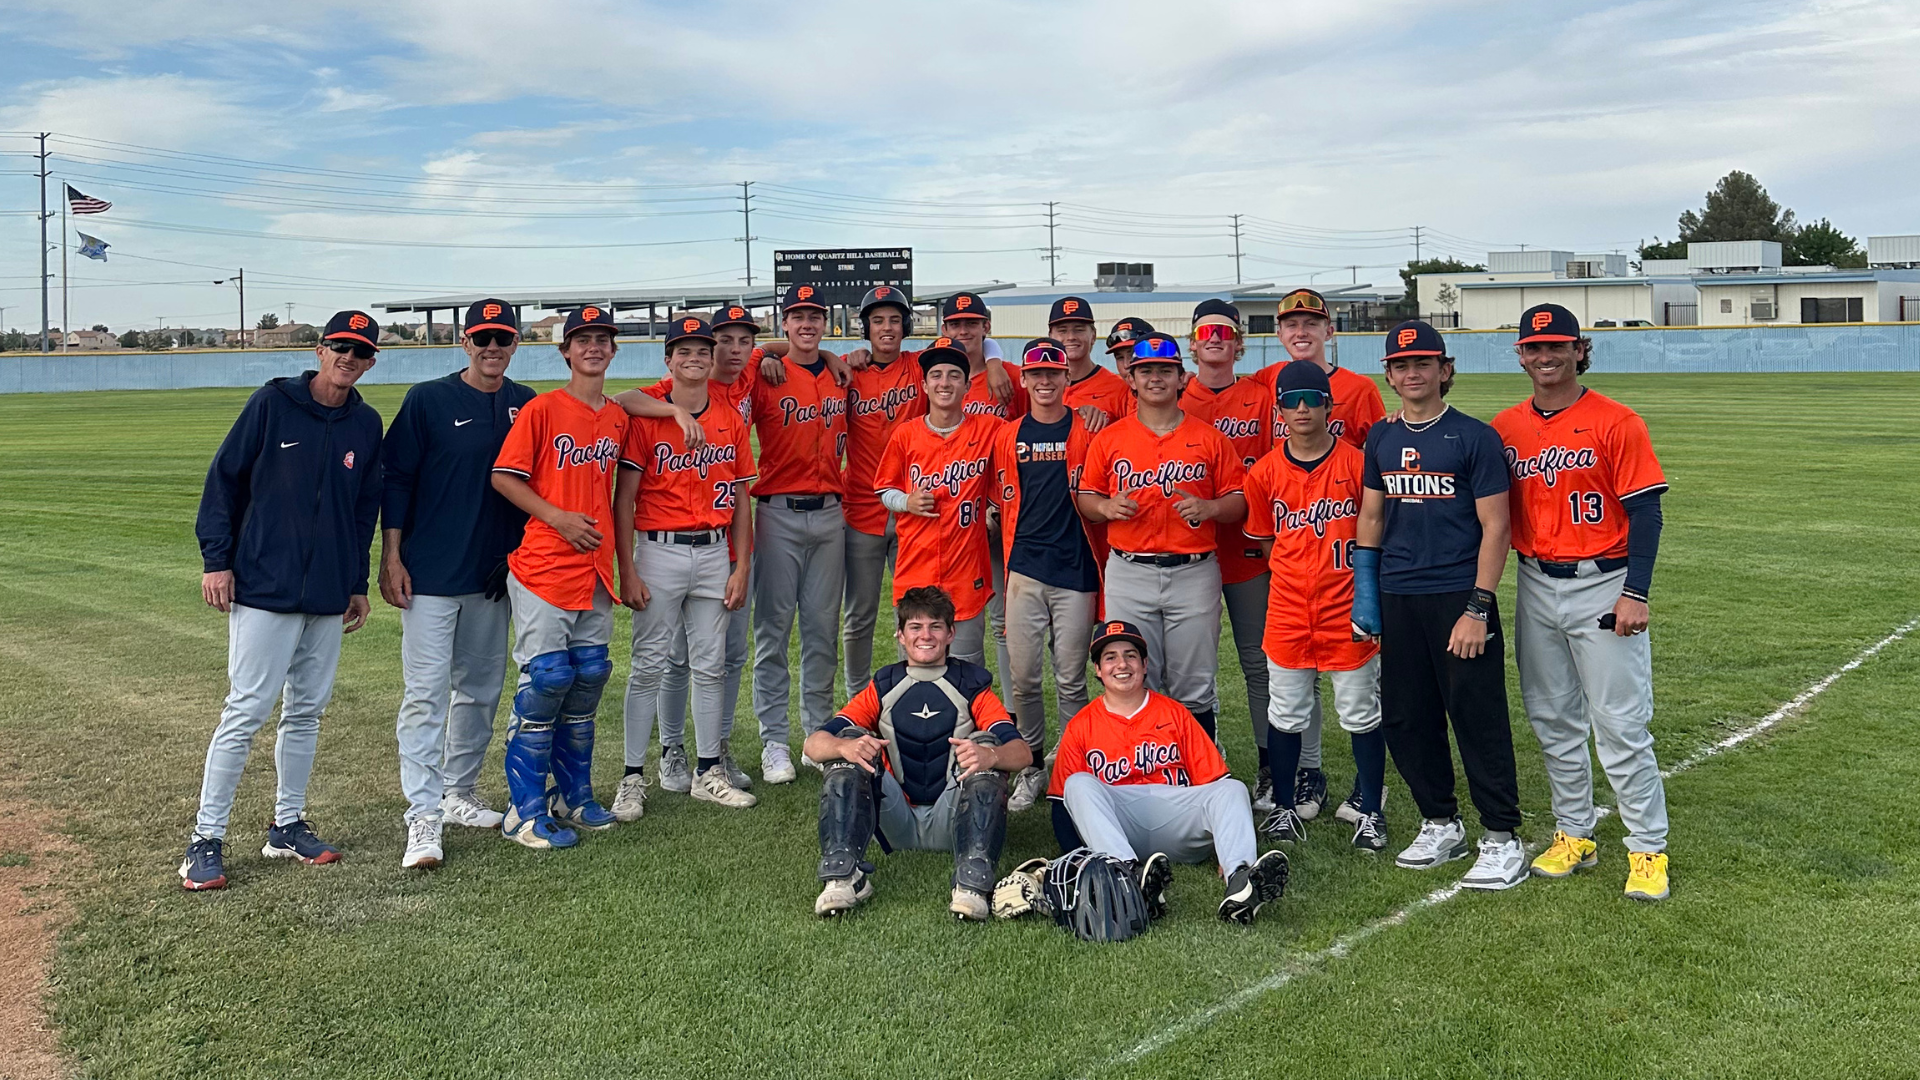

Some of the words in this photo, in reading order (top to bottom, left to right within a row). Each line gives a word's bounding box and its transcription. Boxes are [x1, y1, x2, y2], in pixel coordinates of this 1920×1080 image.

[785, 252, 806, 260] HOME
[807, 252, 817, 260] OF
[818, 252, 845, 260] QUARTZ
[846, 251, 864, 259] HILL
[865, 251, 901, 259] BASEBALL
[810, 264, 823, 272] BALL
[779, 396, 848, 429] Pacific
[849, 383, 918, 421] Pacifica
[654, 442, 736, 480] Pacifica
[1032, 442, 1055, 452] PACIFICA
[909, 457, 988, 497] Pacifica
[1114, 458, 1208, 499] Pacifica
[1503, 445, 1598, 488] Pacifica
[1273, 497, 1357, 539] Pacifica
[1568, 491, 1604, 525] 13
[1085, 740, 1181, 784] Pacifica
